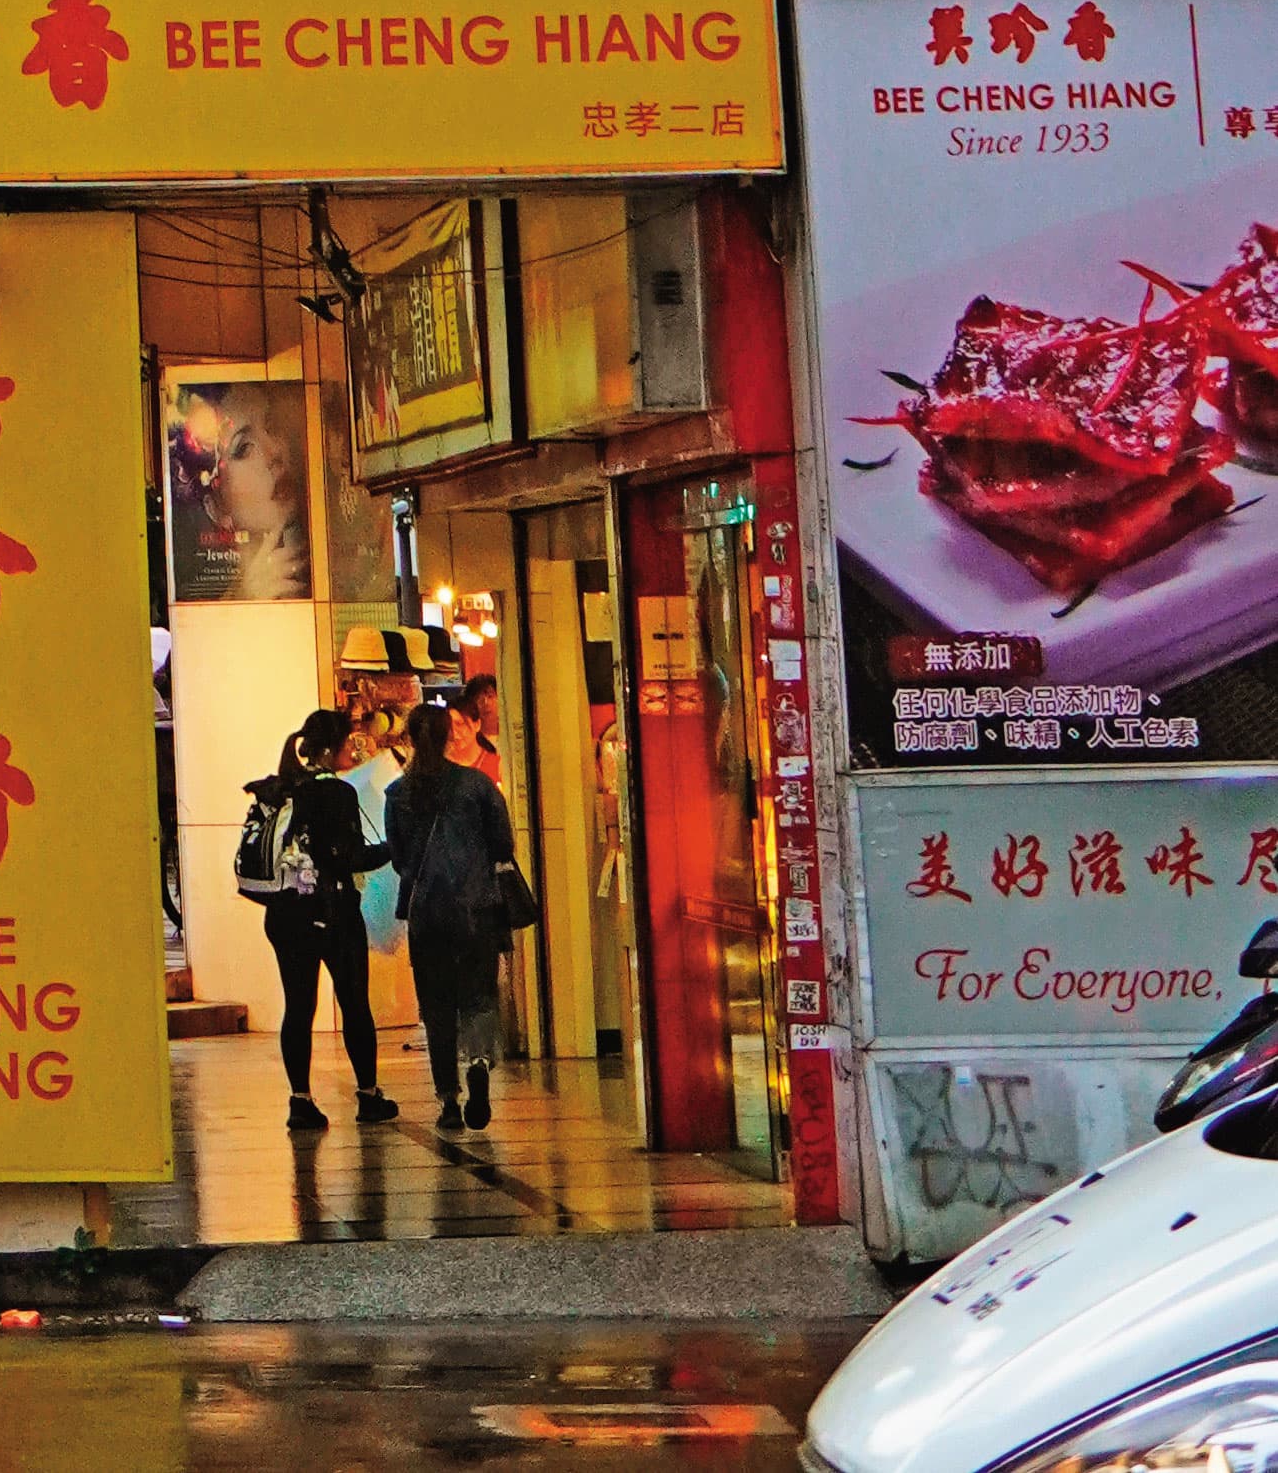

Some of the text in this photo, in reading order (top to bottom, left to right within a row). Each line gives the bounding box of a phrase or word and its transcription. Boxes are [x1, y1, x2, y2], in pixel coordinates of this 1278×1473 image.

[165, 9, 743, 70] BEE CHENG HIANG
[872, 80, 1177, 115] BEE CHENG HIANG
[581, 100, 746, 139] 忠孝二店
[945, 122, 1111, 158] Since 1933
[923, 640, 1012, 673] 無添加
[914, 946, 1003, 1003] For
